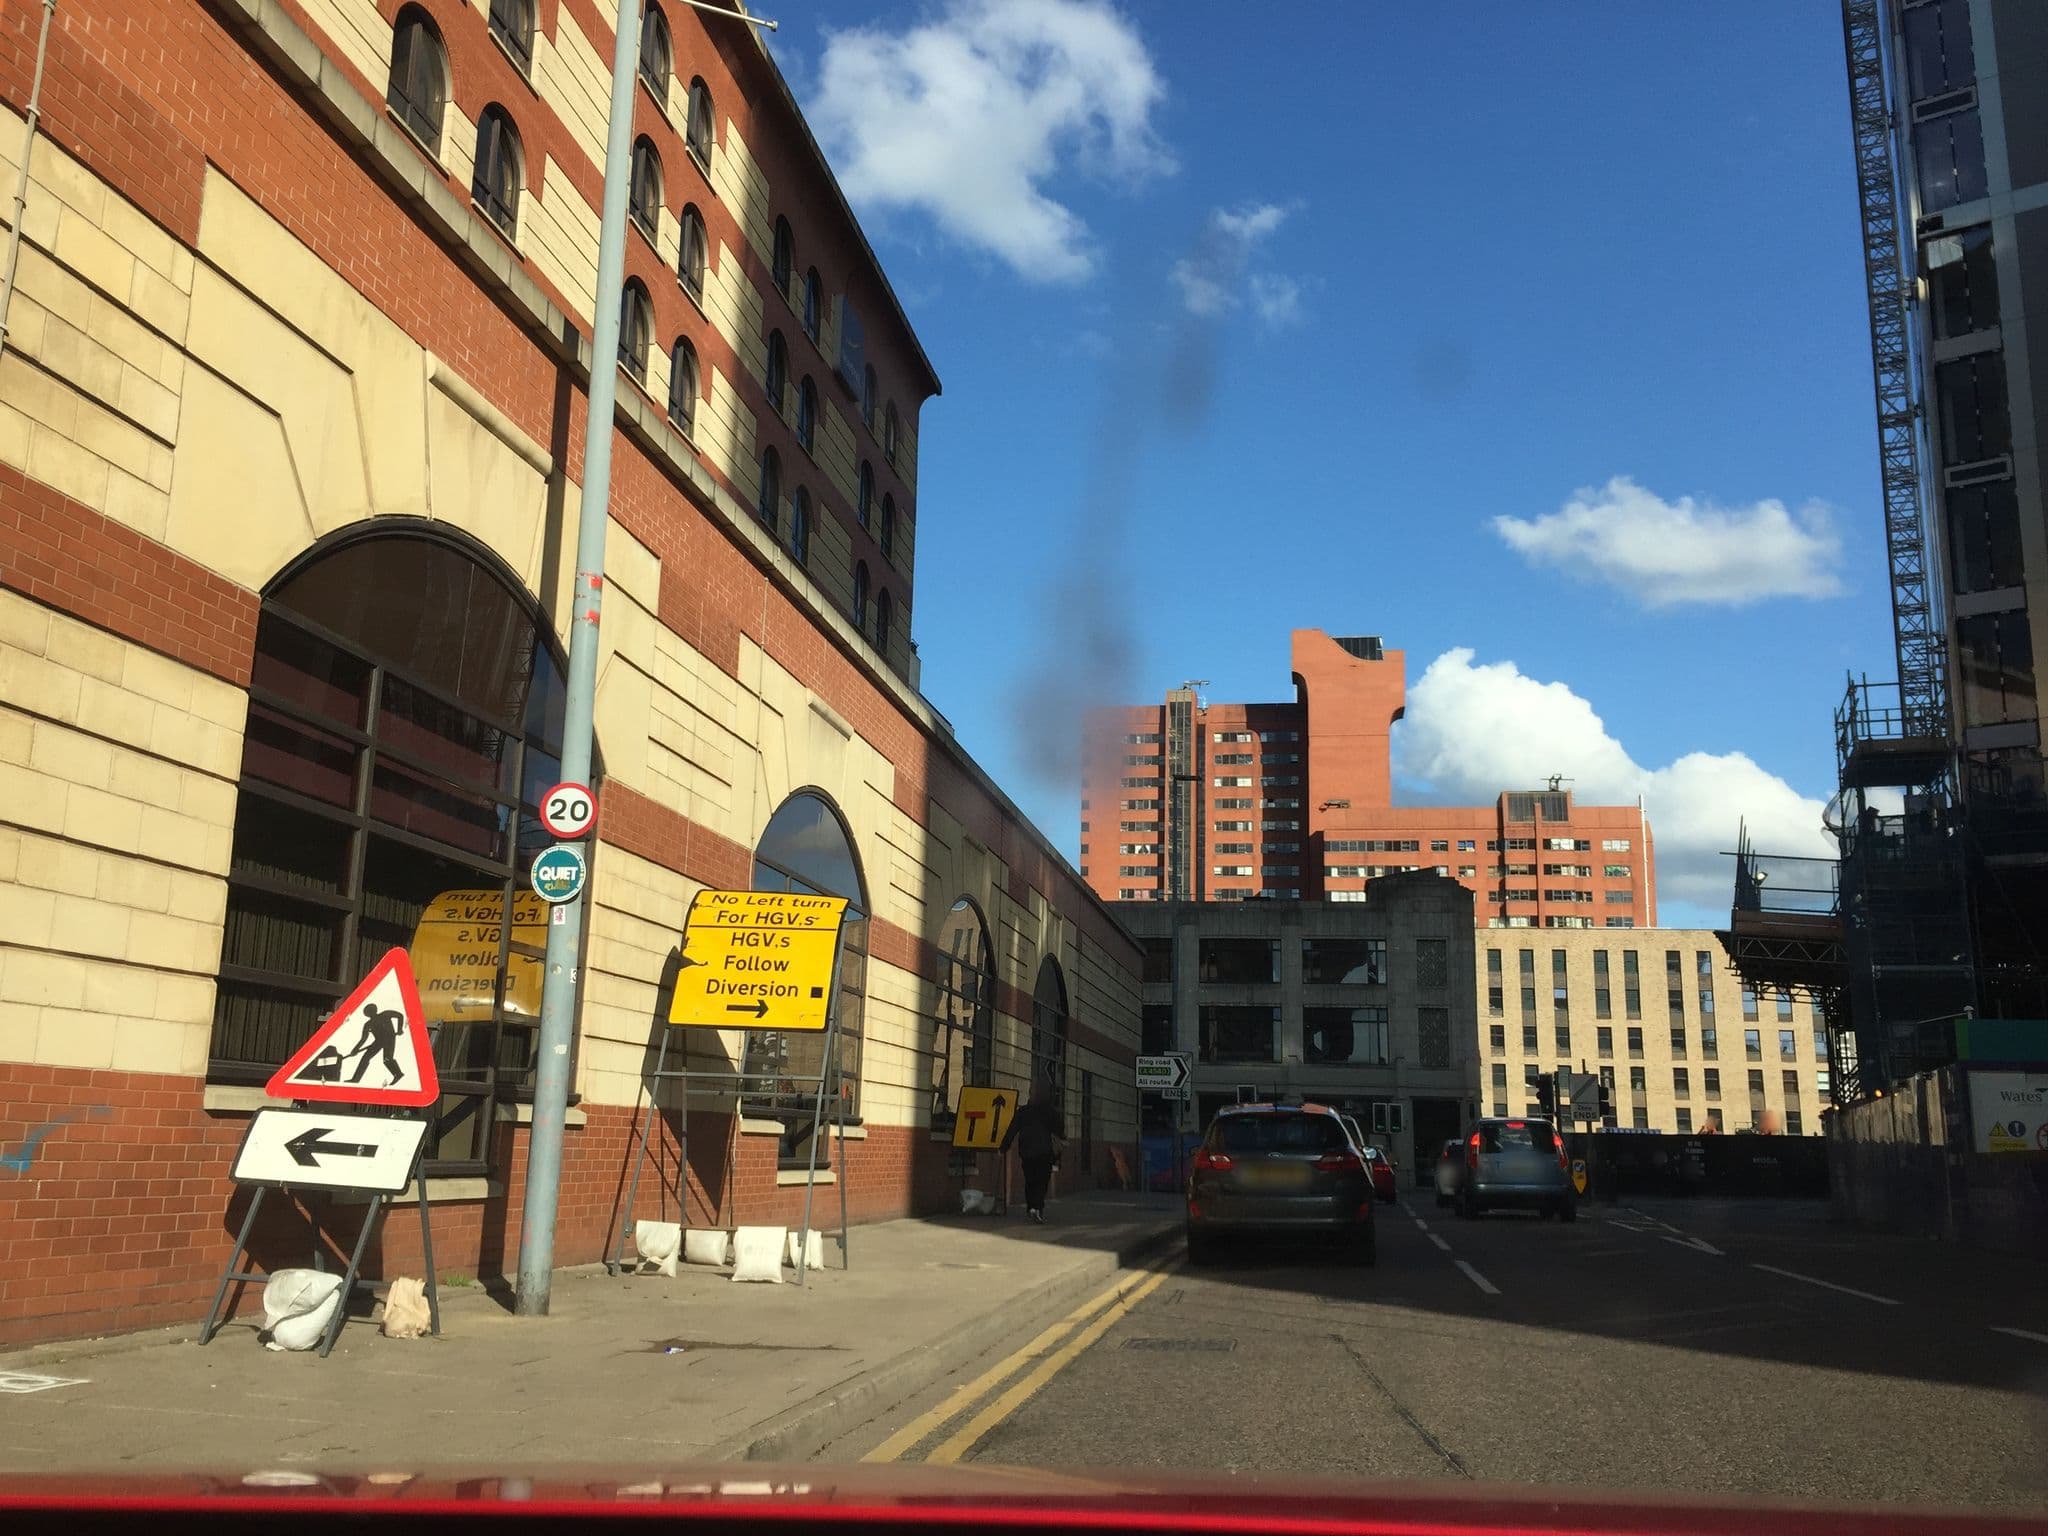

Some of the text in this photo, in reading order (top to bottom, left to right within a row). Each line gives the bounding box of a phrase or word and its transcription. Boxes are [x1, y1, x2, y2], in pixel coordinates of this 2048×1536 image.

[549, 798, 589, 822] 20
[538, 865, 579, 881] QUIET
[711, 894, 832, 909] No Left turn
[716, 910, 749, 924] For
[724, 955, 790, 972] Follow
[705, 979, 799, 998] Diversion
[1138, 1058, 1154, 1066] Ring
[2000, 1090, 2043, 1103] Wates
[1573, 1111, 1597, 1119] ENDS
